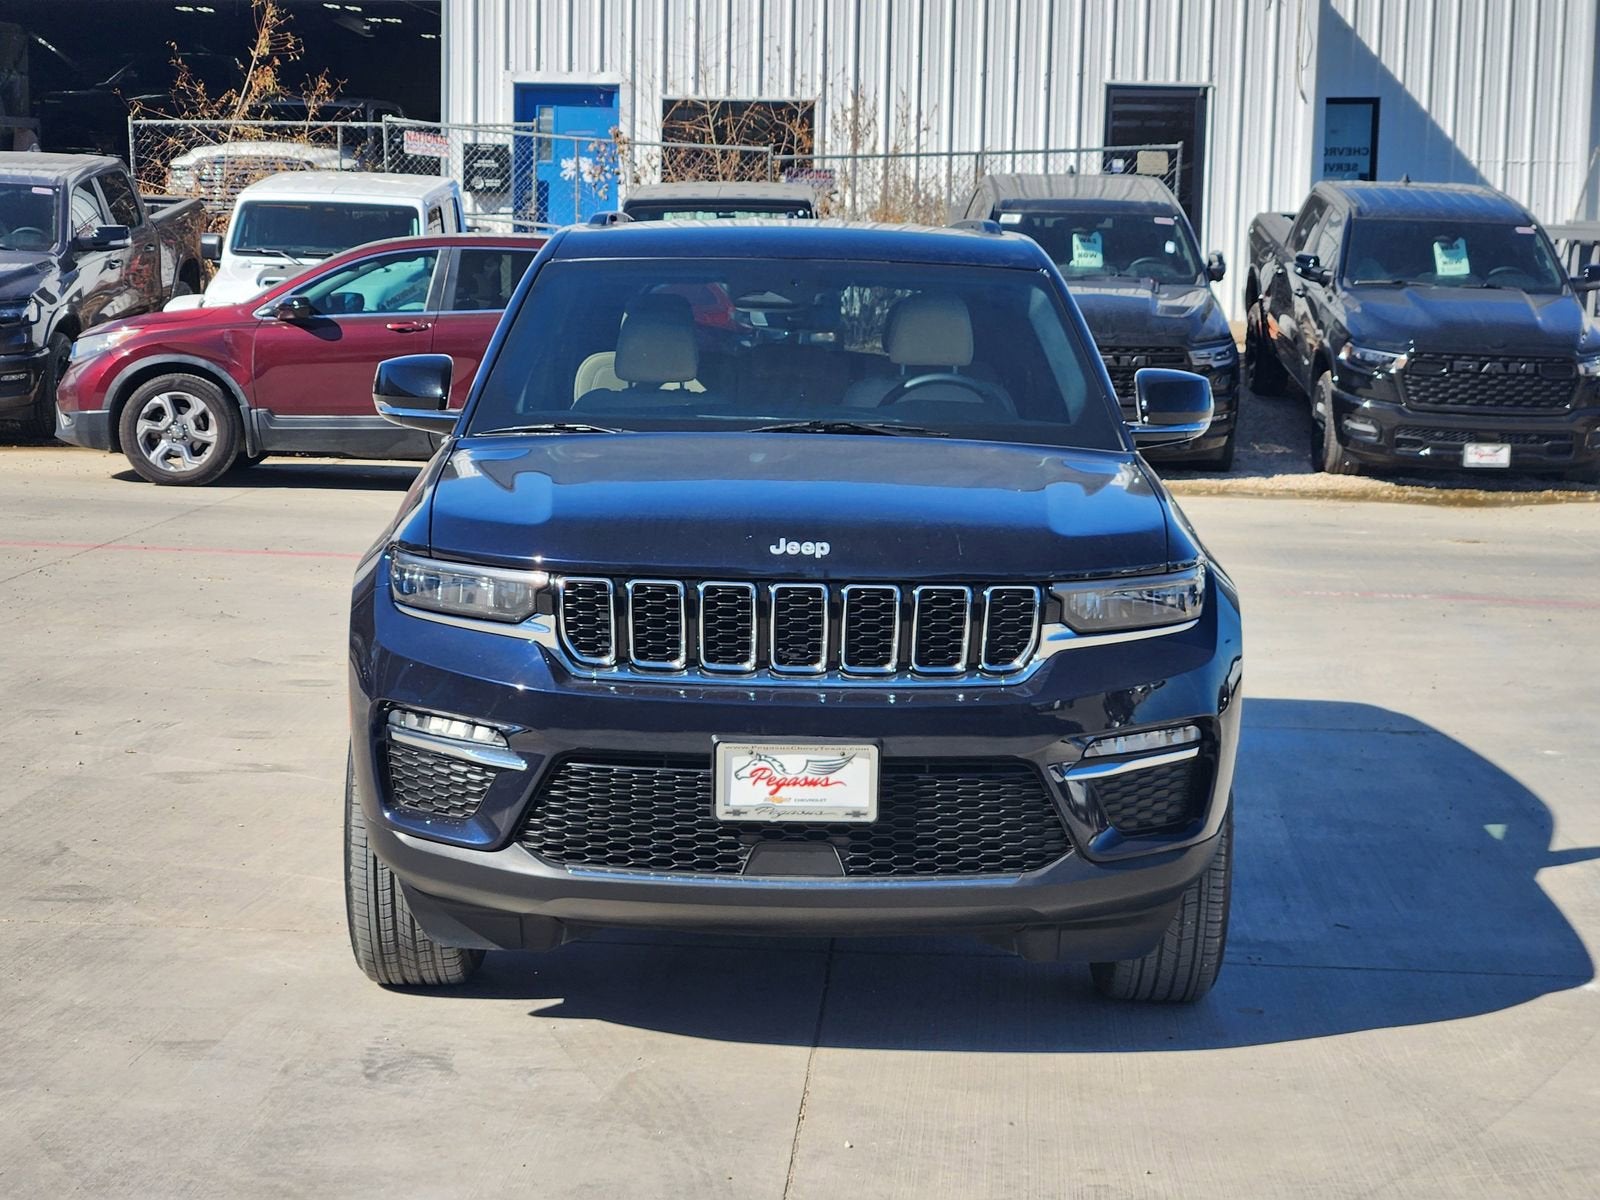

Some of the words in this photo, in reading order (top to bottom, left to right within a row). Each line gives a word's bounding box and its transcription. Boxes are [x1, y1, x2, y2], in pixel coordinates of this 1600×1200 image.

[406, 131, 449, 145] NATIONAL
[1453, 360, 1535, 374] RAM
[769, 537, 831, 559] Jeep
[749, 766, 847, 796] Pegasus
